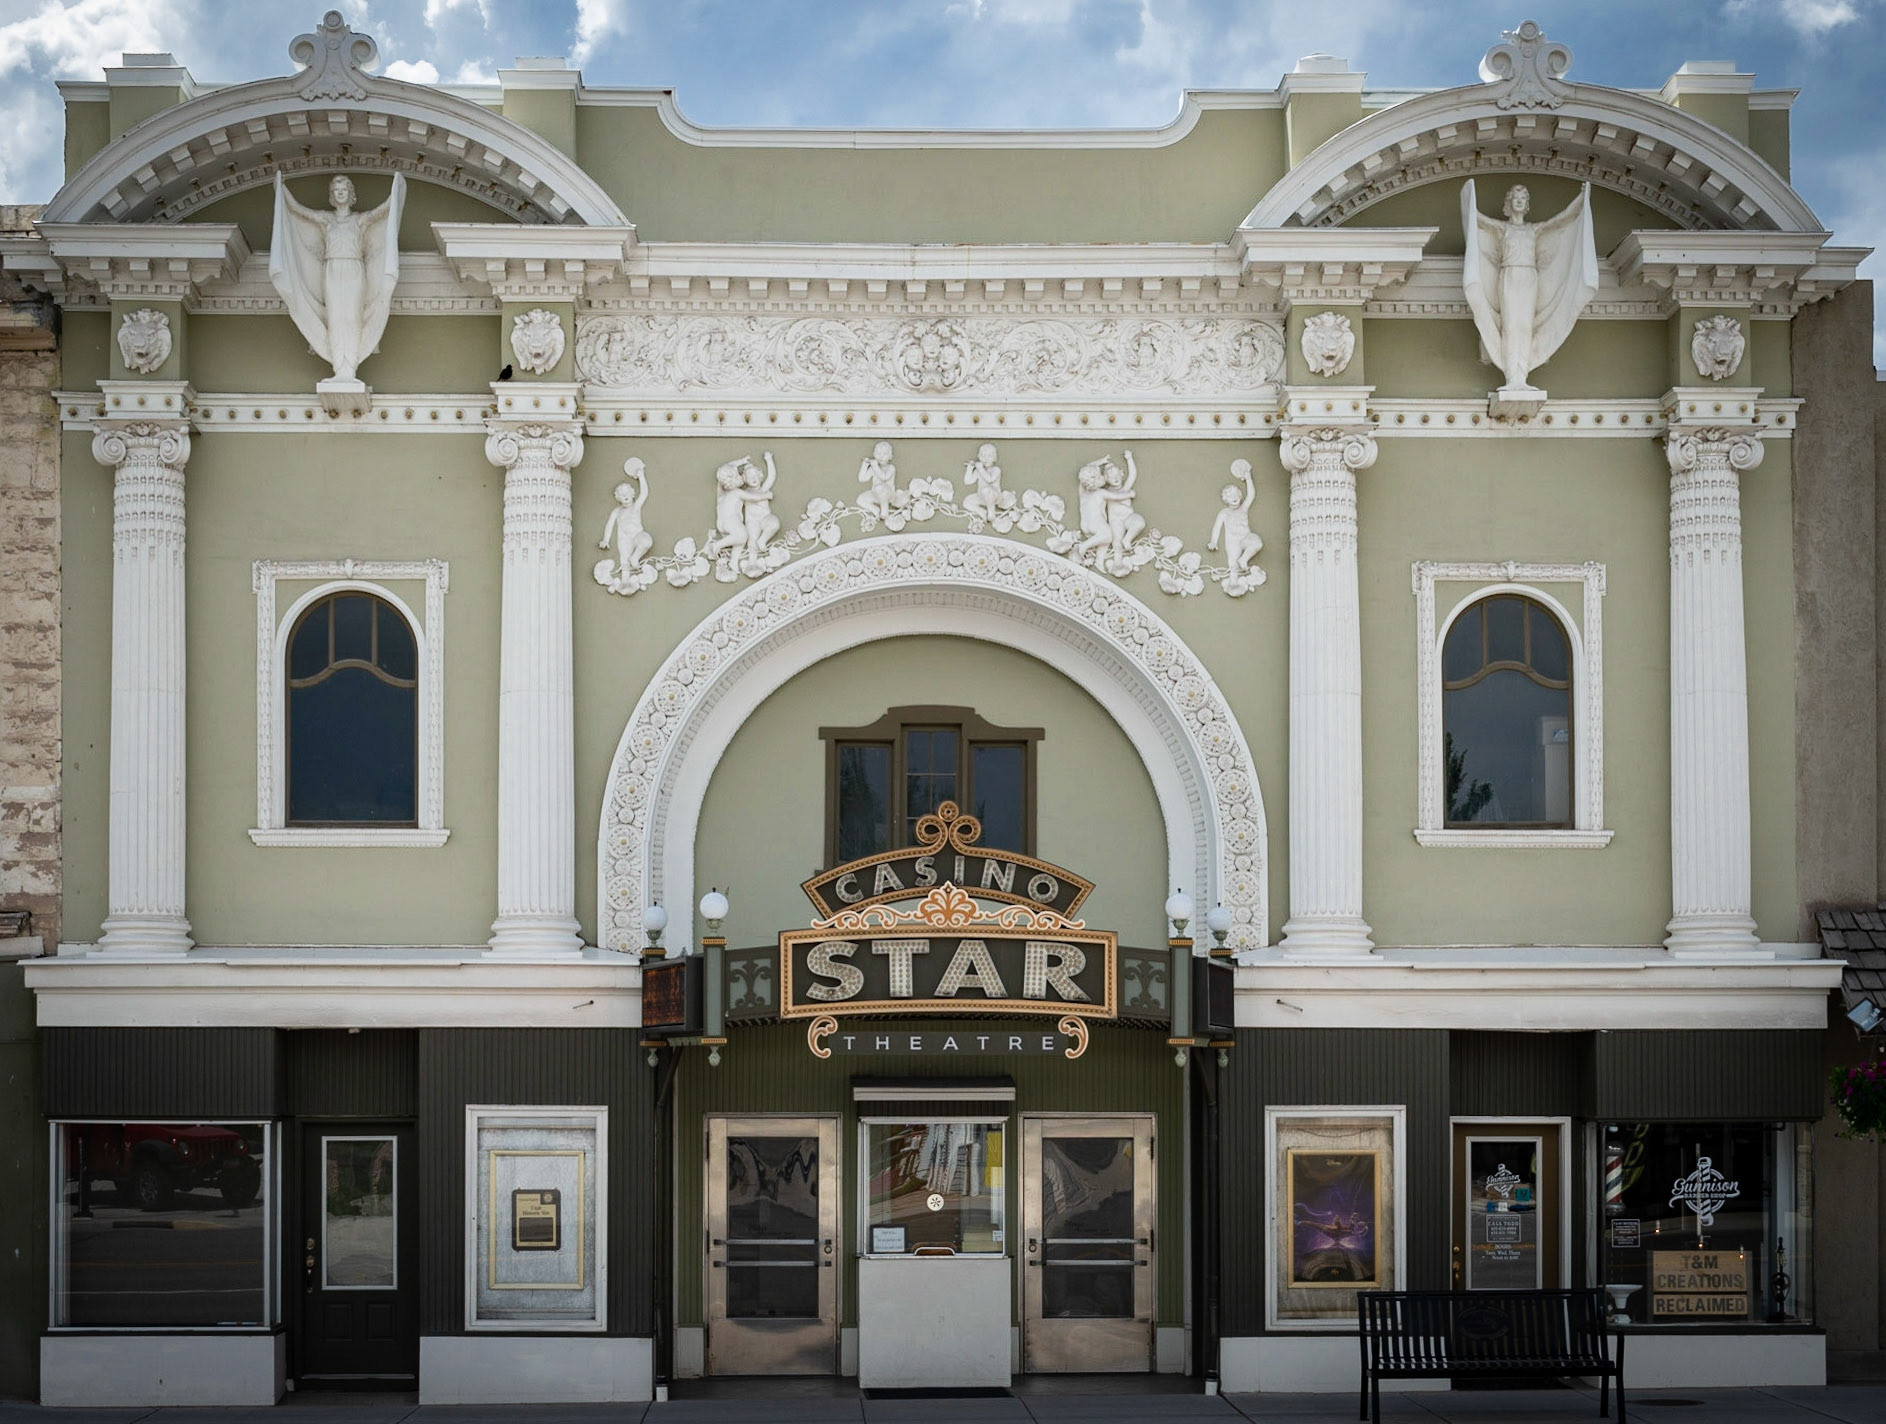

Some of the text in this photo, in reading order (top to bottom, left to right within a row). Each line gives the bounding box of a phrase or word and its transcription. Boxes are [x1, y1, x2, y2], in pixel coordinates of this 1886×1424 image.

[834, 855, 1059, 904] CASINO
[805, 939, 1092, 1002] STAR
[843, 1035, 1055, 1051] THEATRE
[1671, 1177, 1740, 1198] Gunnison
[1681, 1255, 1718, 1269] T&M
[1657, 1274, 1744, 1288] CREATIONS
[1656, 1298, 1745, 1312] RECLAIMED
